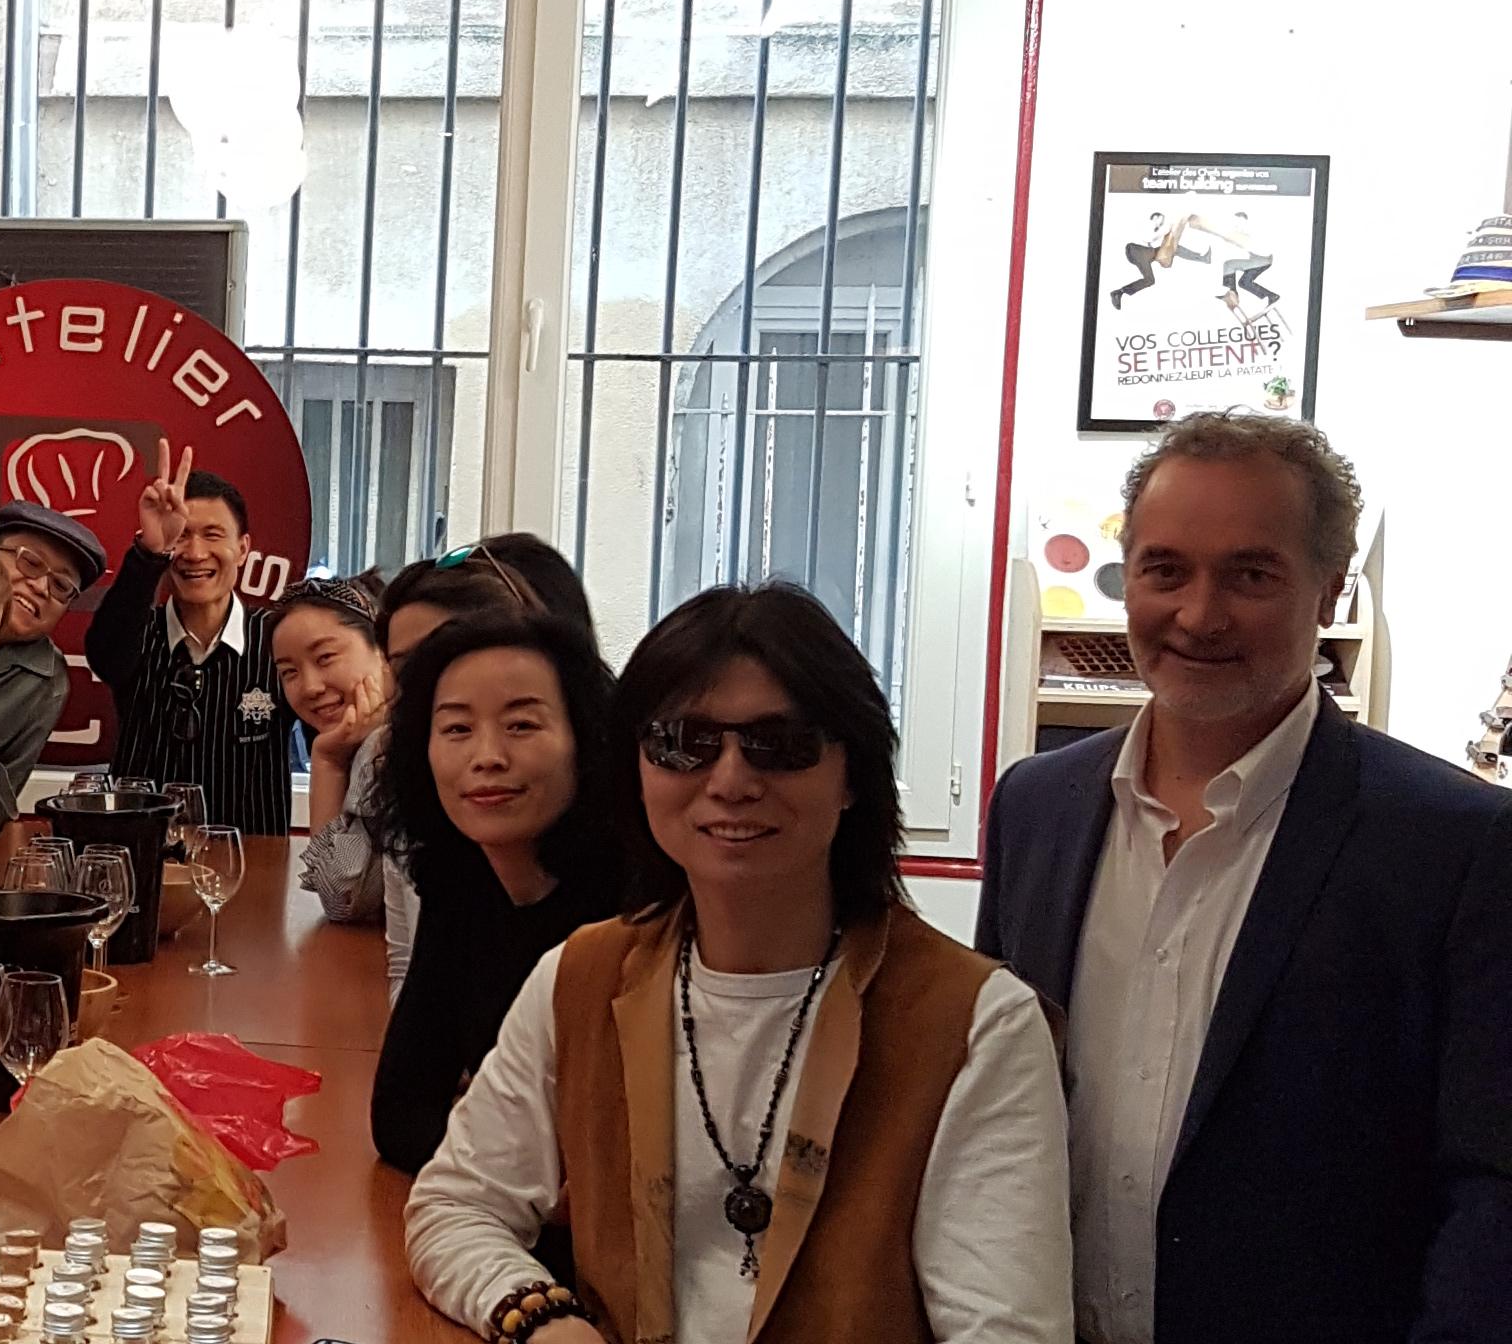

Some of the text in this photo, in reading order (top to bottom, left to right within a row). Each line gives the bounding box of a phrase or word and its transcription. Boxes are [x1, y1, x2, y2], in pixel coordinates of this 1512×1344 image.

[1142, 177, 1178, 189] team
[1179, 176, 1234, 194] building
[1115, 324, 1281, 352] VOS COLLEGUES
[1117, 352, 1149, 374] SE
[1157, 343, 1260, 370] FRITENT
[1117, 370, 1214, 386] REDONNEZ-LEUR
[1218, 367, 1232, 378] LA
[1237, 365, 1273, 376] PATATE
[1063, 682, 1121, 692] KRUPS
